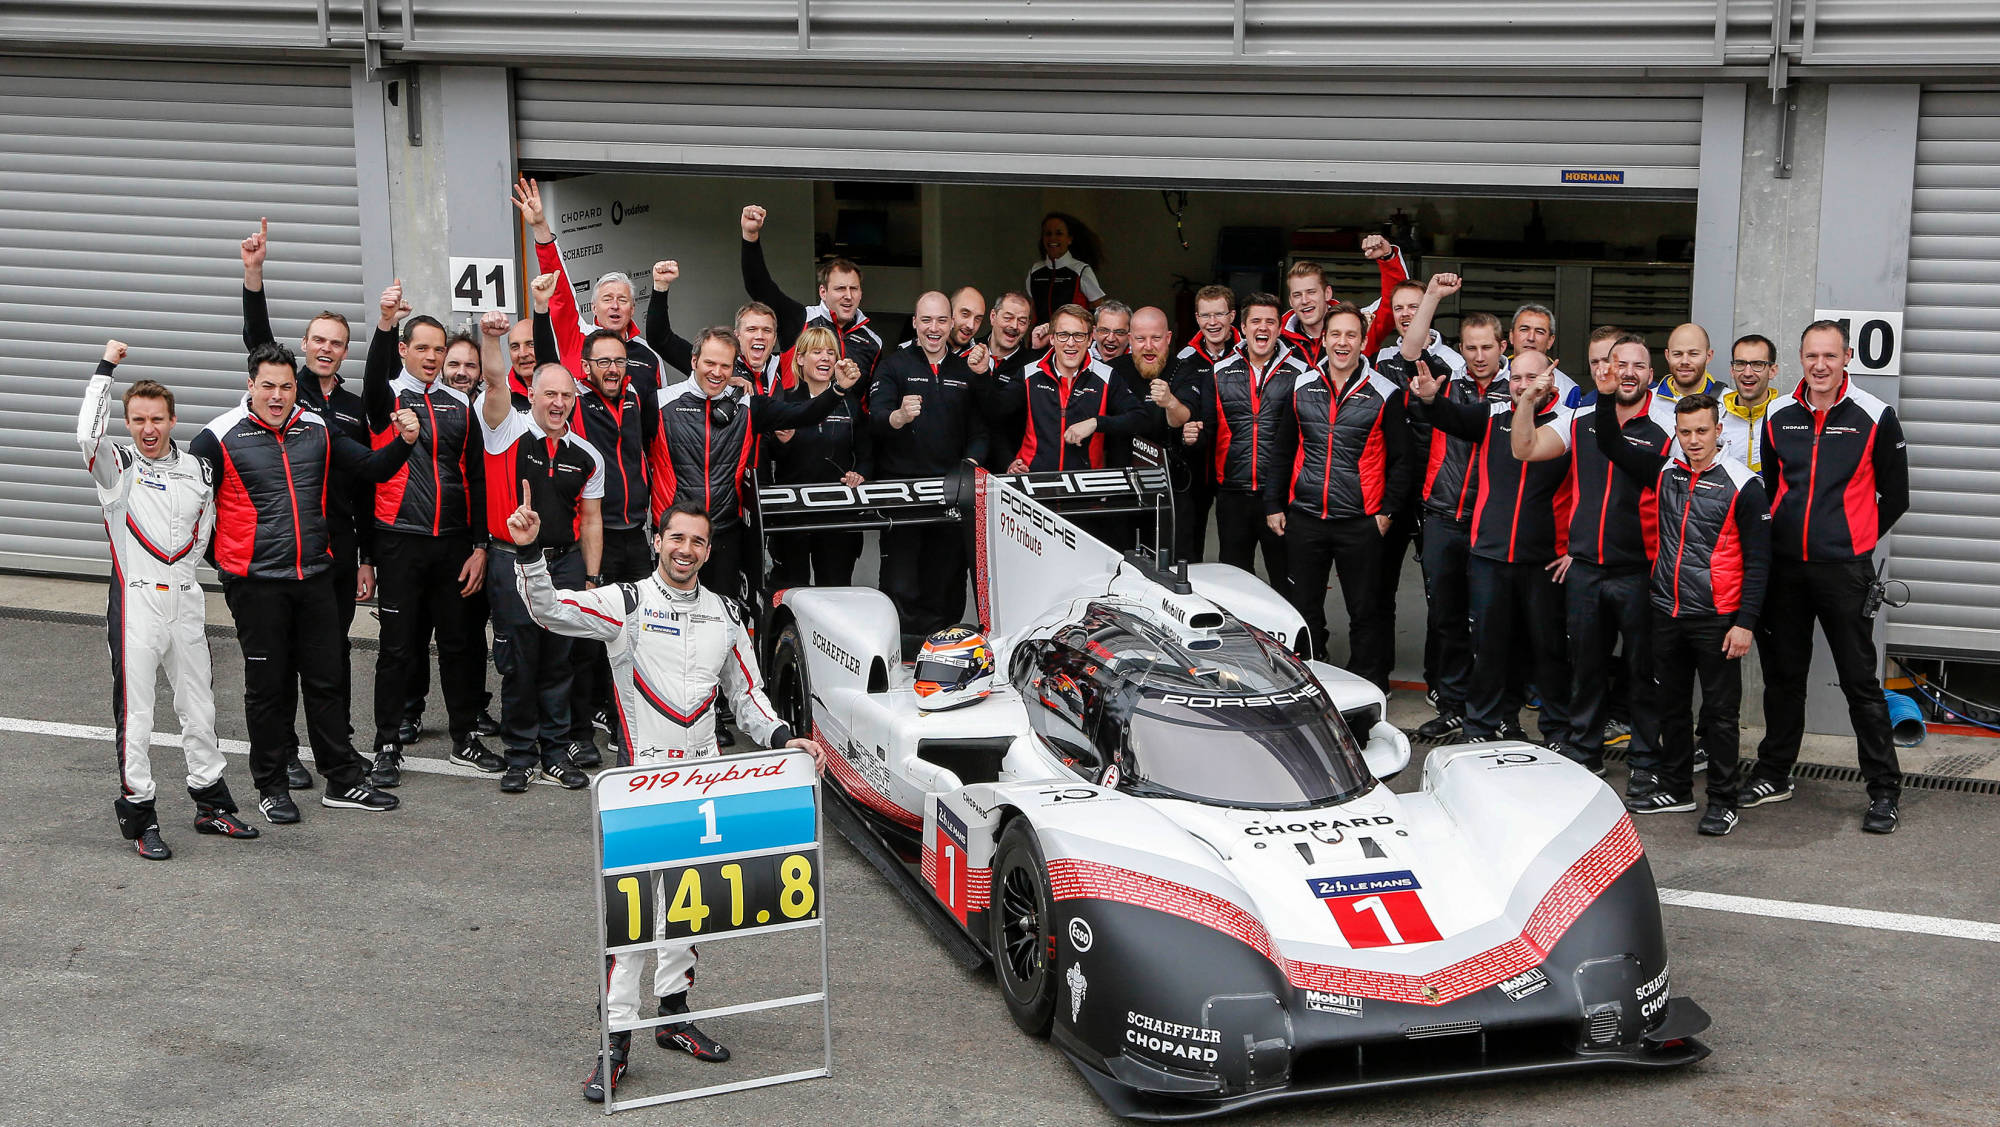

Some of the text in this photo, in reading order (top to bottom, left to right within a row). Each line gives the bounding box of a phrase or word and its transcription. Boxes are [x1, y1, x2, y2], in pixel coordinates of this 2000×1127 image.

[561, 207, 602, 224] CHOPARD
[562, 243, 604, 260] SCHAEFFLER
[455, 264, 507, 307] 41
[1132, 437, 1159, 458] CHOPARD
[1000, 489, 1076, 550] PORSCHE
[1000, 512, 1042, 557] 919 tribute
[644, 607, 669, 619] Mobil
[812, 630, 860, 676] SCHAEFFLER
[1161, 684, 1321, 708] PORSCHE
[628, 758, 788, 795] 919 hybrid
[962, 792, 988, 820] CHOPARD
[698, 799, 722, 844] 1
[1244, 816, 1394, 836] CHOPARD
[945, 844, 955, 909] 1
[1317, 878, 1412, 894] 24h LE MANS
[1351, 895, 1405, 944] 1
[1306, 990, 1347, 1006] Mobil
[1497, 972, 1534, 994] Mobil
[1127, 1010, 1221, 1043] SCHAEFFLER
[1126, 1029, 1218, 1062] CHOPARD
